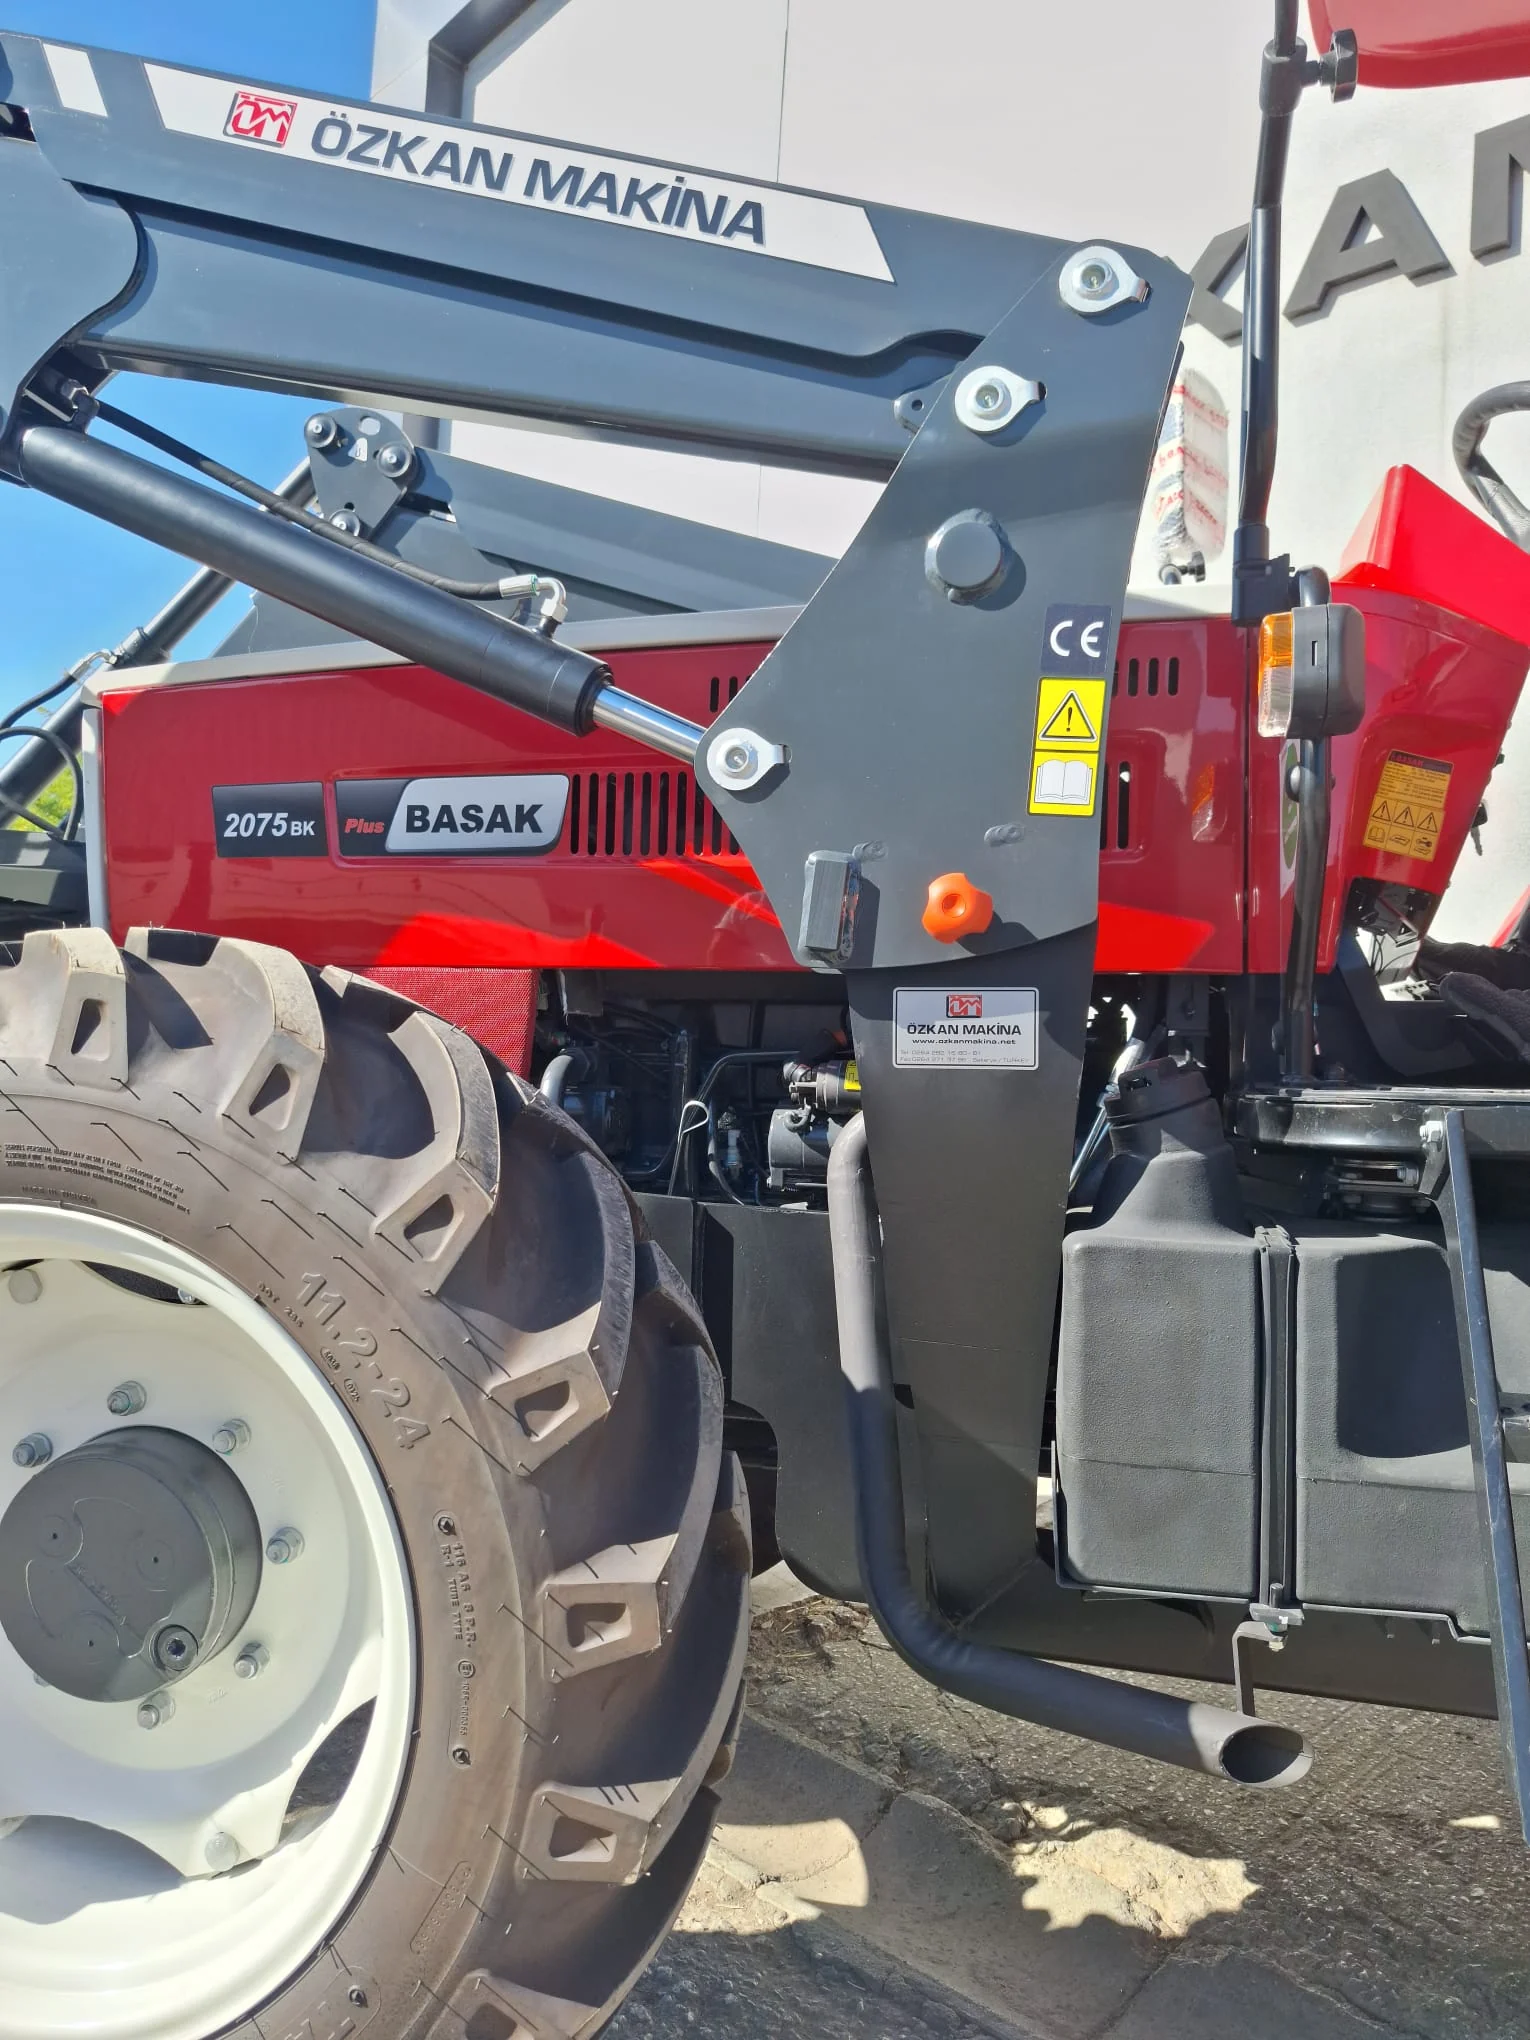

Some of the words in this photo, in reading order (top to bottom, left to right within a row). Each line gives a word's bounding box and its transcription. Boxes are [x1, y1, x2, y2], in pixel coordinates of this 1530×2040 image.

[311, 110, 514, 192] ÖZKAN
[523, 158, 766, 246] MAKİNA
[344, 818, 385, 834] Plus
[907, 1022, 959, 1035] ÖZKAN
[962, 1022, 1022, 1036] MAKİNA
[912, 1038, 1017, 1046] www.ozkanmakina.net
